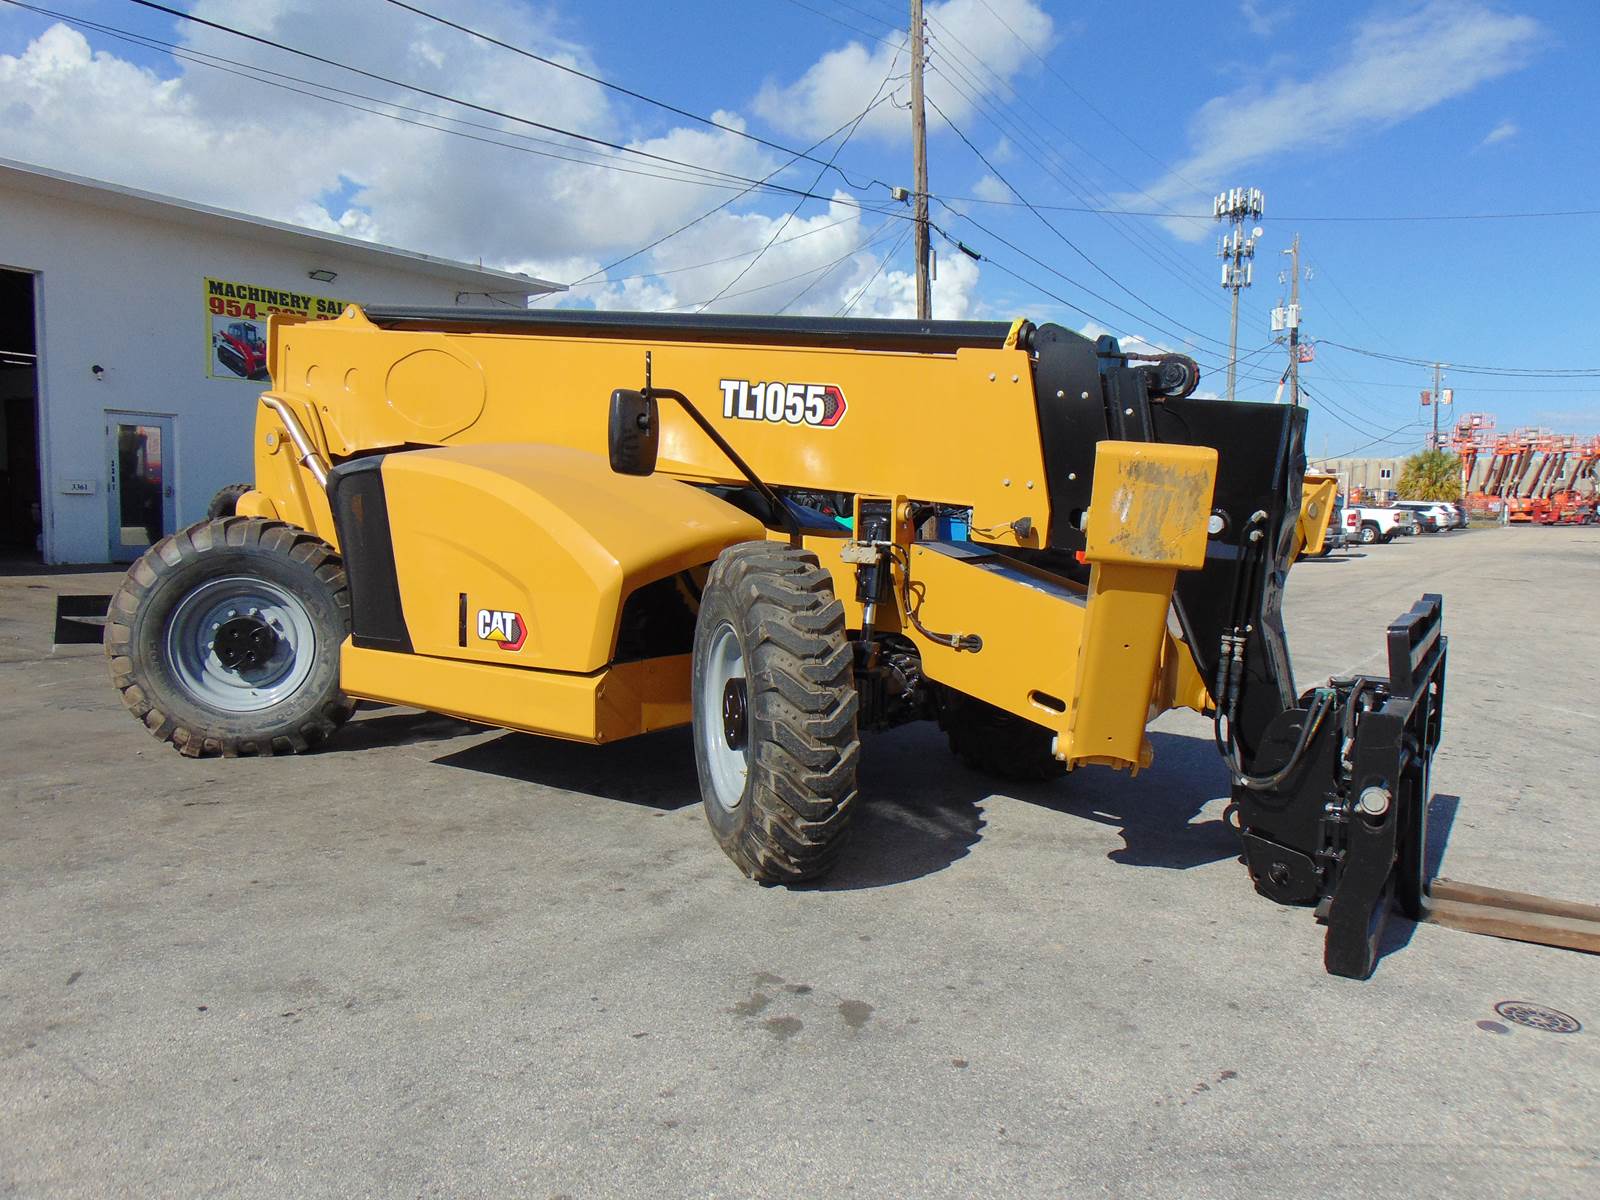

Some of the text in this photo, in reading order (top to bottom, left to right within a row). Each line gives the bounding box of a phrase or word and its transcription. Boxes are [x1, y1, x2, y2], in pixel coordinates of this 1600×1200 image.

[209, 280, 345, 316] MACHINERY SAL
[718, 378, 827, 424] TL1055
[478, 609, 517, 643] CAT
